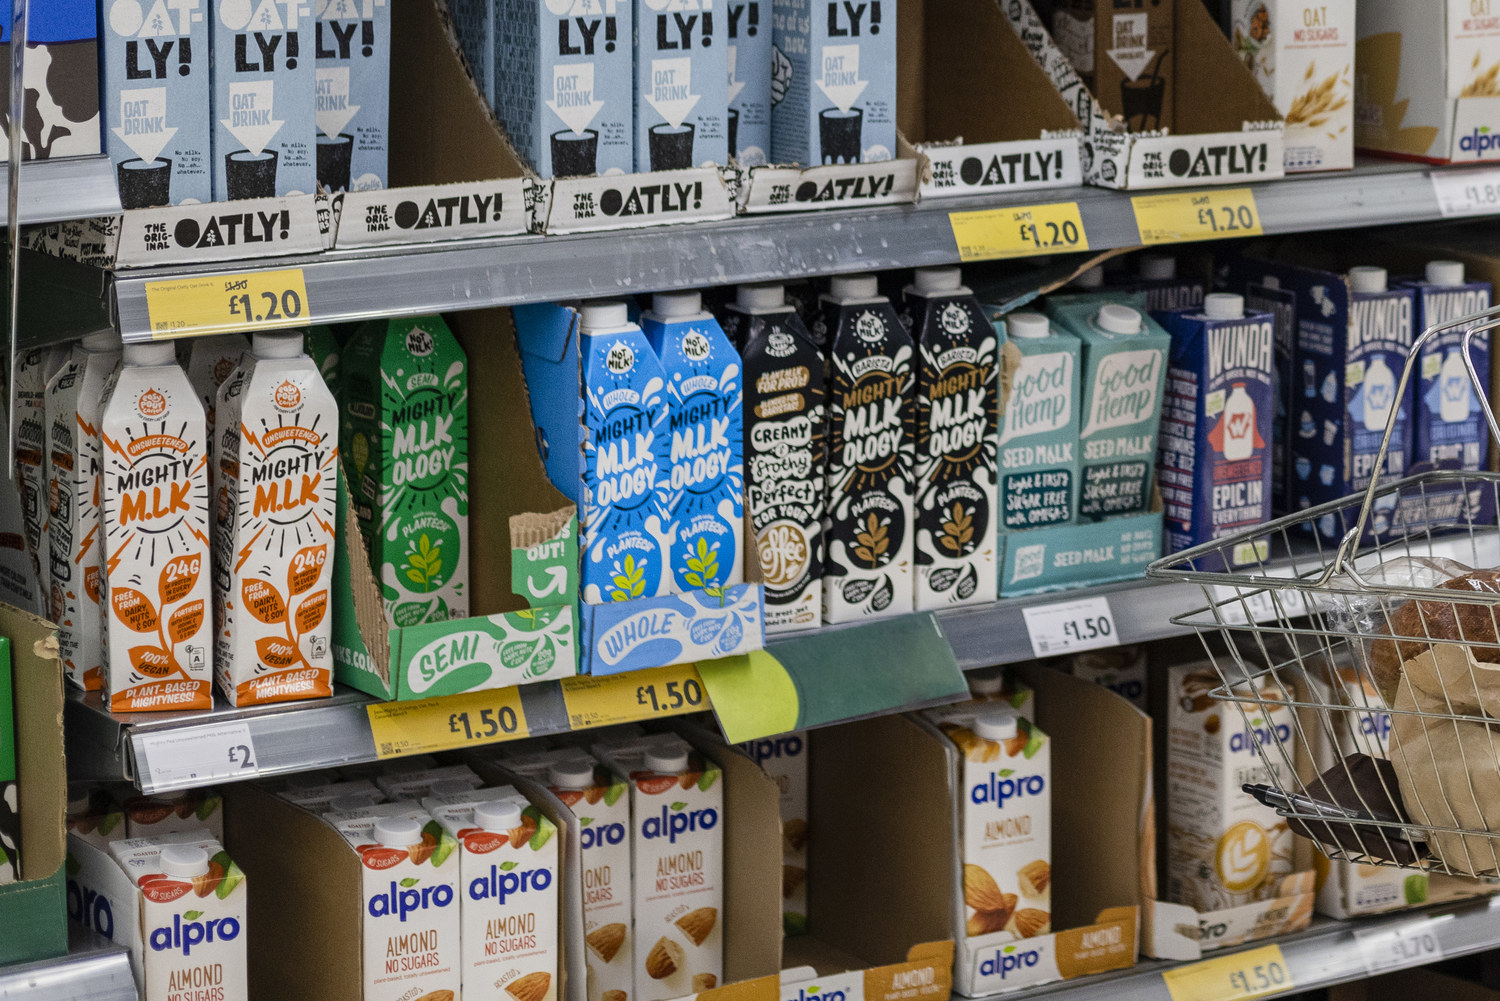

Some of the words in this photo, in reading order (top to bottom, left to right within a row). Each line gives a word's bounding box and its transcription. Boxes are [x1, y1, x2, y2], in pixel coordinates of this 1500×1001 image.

[826, 0, 882, 38] LY!
[1303, 7, 1328, 28] OAT
[1294, 28, 1305, 42] NO
[1306, 27, 1339, 42] SUGARS
[126, 37, 192, 81] LY!
[824, 70, 856, 89] DRINK
[1168, 144, 1268, 179] OATLY!
[600, 181, 704, 218] OATLY!
[1198, 204, 1254, 233] £1.20
[1020, 220, 1080, 248] £1.20
[228, 290, 302, 323] £1.20
[407, 340, 434, 354] MILK!
[408, 332, 426, 343] NOT
[1207, 322, 1272, 380] WUNDA
[853, 359, 891, 375] BARISTA
[410, 374, 436, 390] SEMI
[928, 368, 992, 401] MIGHTY
[140, 401, 164, 410] pour
[142, 392, 162, 402] easy
[392, 391, 459, 426] MIGHTY
[604, 388, 638, 410] WHOLE
[930, 386, 987, 433] M.LK
[670, 392, 732, 432] MIGHTY
[130, 436, 187, 455] UNSWEETENED
[392, 414, 456, 460] M.LK
[670, 418, 730, 461] M.LK
[754, 422, 810, 443] CREAMY
[929, 418, 988, 458] OLOGY
[1083, 440, 1115, 460] SEED
[117, 458, 194, 494] MIGHTY
[392, 446, 456, 486] OLOGY
[672, 450, 731, 491] OLOGY
[755, 452, 809, 478] frothy
[119, 480, 192, 527] M.LK
[751, 482, 813, 511] perfect
[1043, 490, 1068, 507] FREE
[1212, 484, 1245, 511] EPIC
[1247, 481, 1263, 503] IN
[780, 504, 808, 524] YOUR
[402, 517, 450, 538] PLANTECH
[526, 542, 566, 562] OUT!
[166, 557, 200, 583] 24G
[114, 591, 134, 603] FREE
[118, 597, 141, 610] FROM
[124, 604, 148, 618] DAIRY,
[130, 612, 149, 624] NUTS
[142, 617, 157, 630] SOY
[174, 603, 203, 619] FORTIFIED
[604, 611, 677, 660] WHOLE
[1064, 616, 1111, 641] £1.50
[138, 662, 171, 676] VEGAN
[140, 651, 169, 665] 100%
[420, 633, 480, 682] SEMI
[126, 680, 201, 699] PLANT-BASED
[249, 669, 320, 691] PLANT-BASED
[130, 692, 195, 708] MIGHTYNESS!
[636, 678, 702, 712] £1.50
[448, 705, 518, 740] £1.50
[1229, 722, 1290, 755] alpro
[228, 744, 255, 769] £2
[971, 770, 1045, 809] alpro
[150, 890, 160, 901] NO
[160, 886, 184, 899] SUGARS
[468, 864, 552, 905] alpro
[655, 878, 668, 893] NO
[668, 872, 704, 892] SUGARS
[150, 913, 240, 956] alpro
[485, 912, 536, 938] ALMOND
[168, 963, 224, 992] ALMOND
[1230, 962, 1286, 994] £1.50
